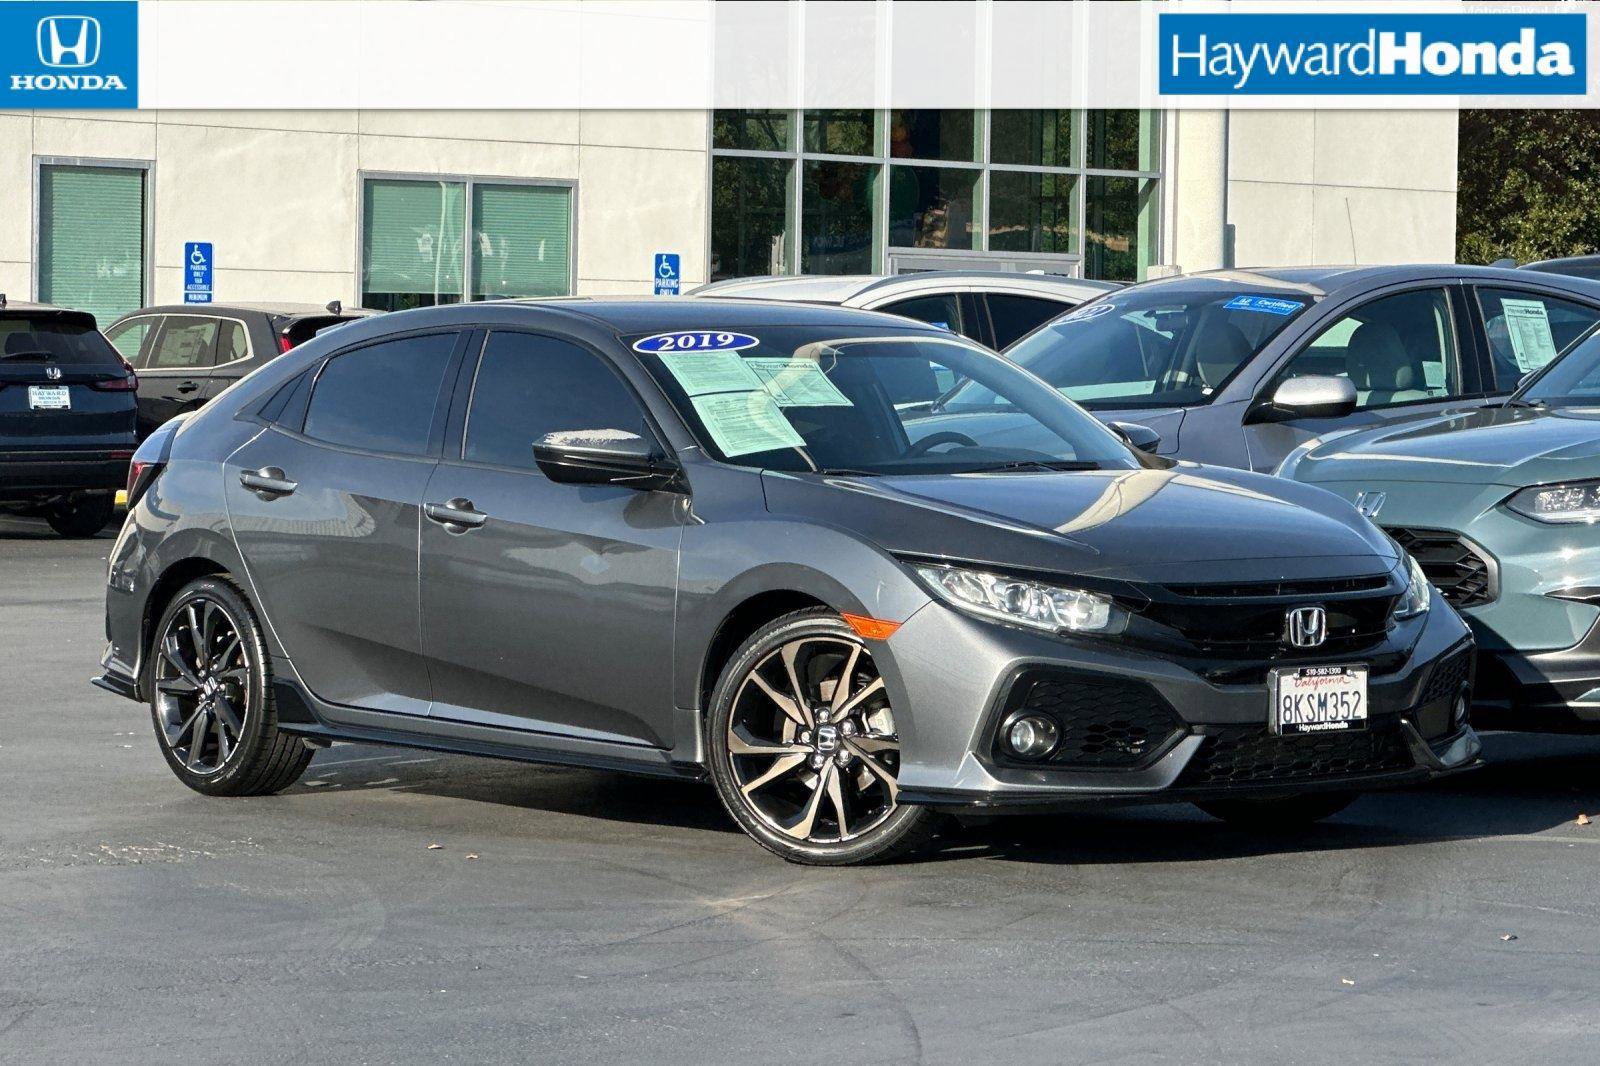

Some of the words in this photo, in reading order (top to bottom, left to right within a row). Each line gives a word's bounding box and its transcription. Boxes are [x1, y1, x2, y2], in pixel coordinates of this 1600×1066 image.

[655, 277, 679, 288] PARKING
[657, 334, 735, 351] 2019
[1294, 675, 1351, 690] California
[1283, 691, 1361, 724] 8KSM352
